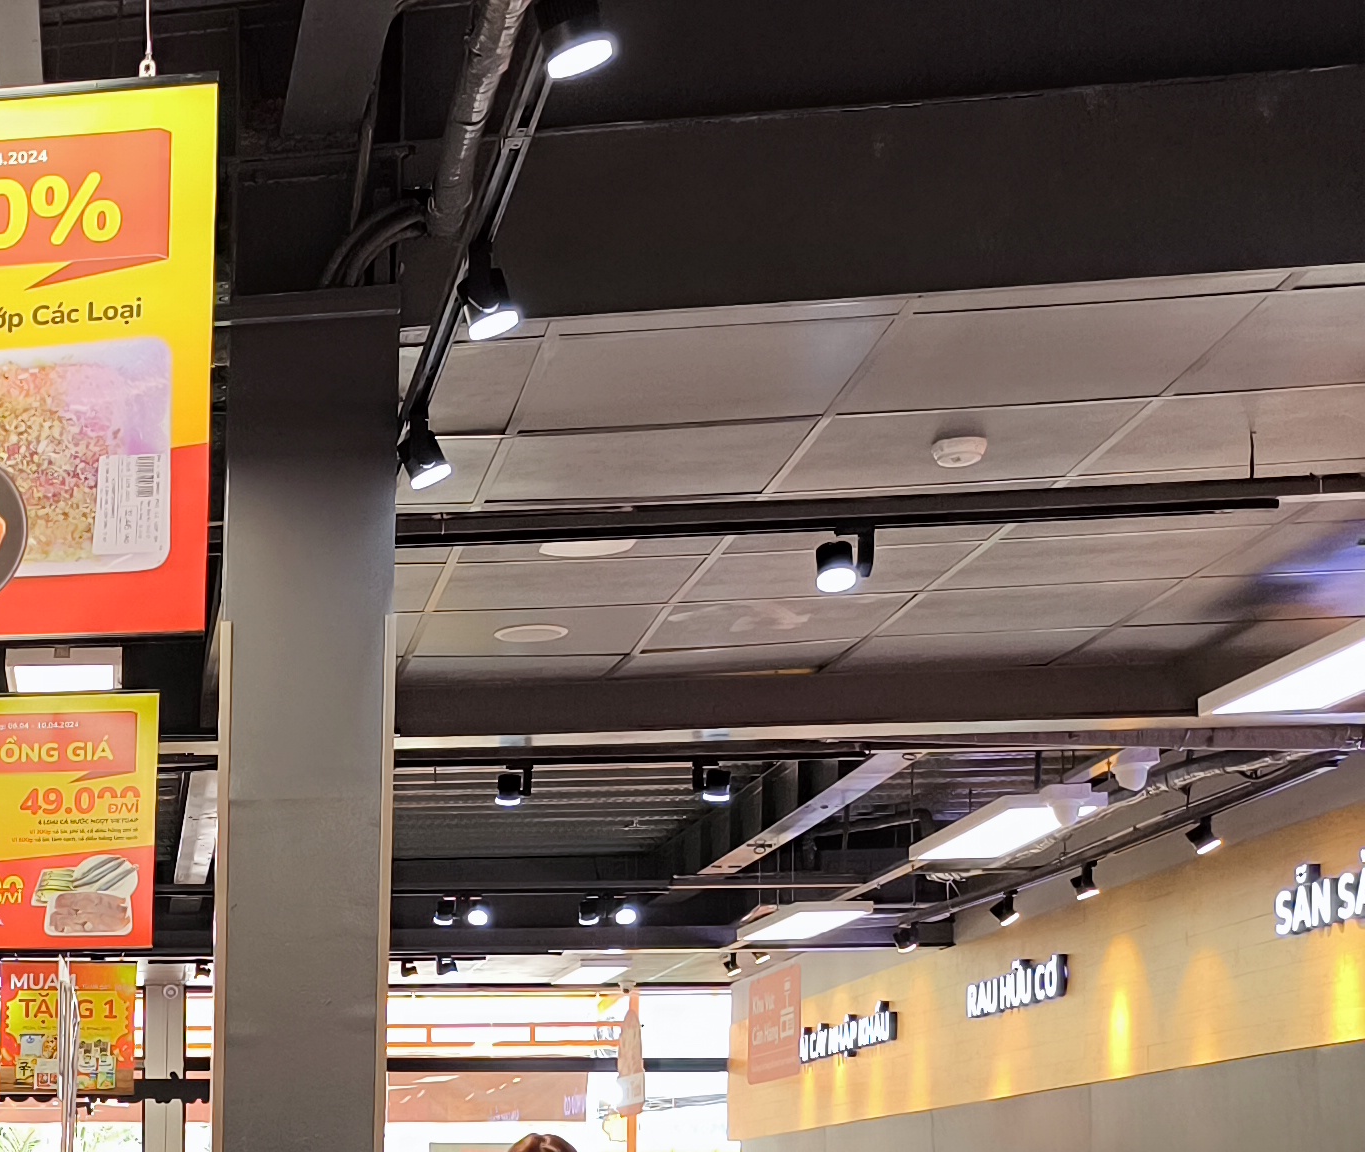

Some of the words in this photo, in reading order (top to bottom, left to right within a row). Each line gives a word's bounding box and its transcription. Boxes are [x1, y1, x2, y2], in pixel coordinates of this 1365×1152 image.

[32, 301, 80, 327] Các
[86, 296, 143, 323] Loại
[66, 735, 113, 762] GIÁ
[10, 973, 58, 990] MUA
[19, 993, 94, 1024] TẶG
[104, 999, 117, 1019] 1
[966, 981, 998, 1018] RAU
